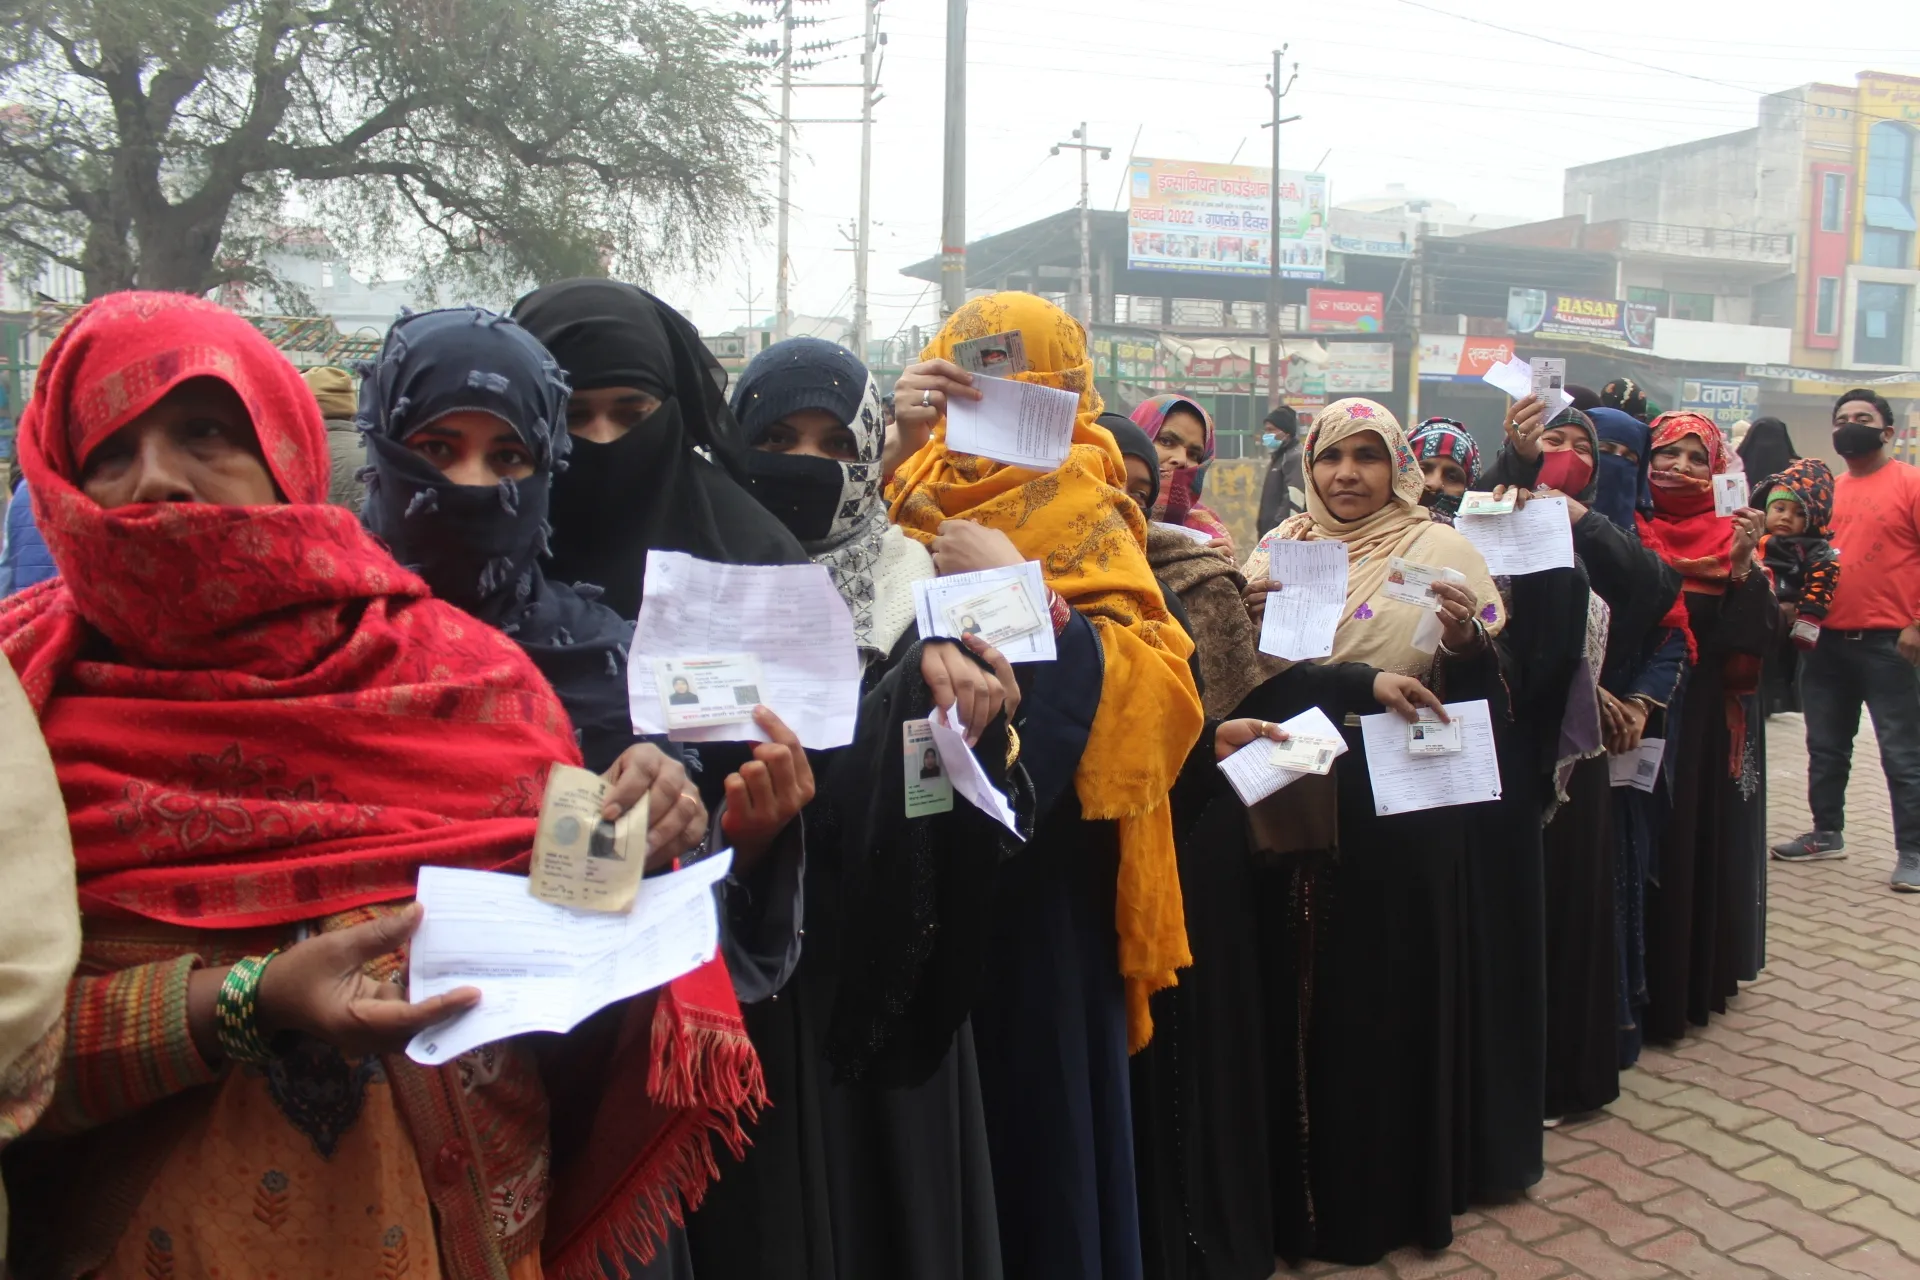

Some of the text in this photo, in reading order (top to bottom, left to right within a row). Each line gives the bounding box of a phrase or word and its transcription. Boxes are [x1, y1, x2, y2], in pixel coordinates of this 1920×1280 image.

[1158, 168, 1217, 194] इन्सानियत
[1132, 204, 1164, 222] नववर्ष
[1168, 209, 1194, 224] 2022
[1205, 210, 1240, 229] गणतंत्र
[1242, 211, 1269, 230] दिवस
[1332, 301, 1377, 313] NEROLAC
[1556, 297, 1618, 318] HASAN
[1555, 313, 1616, 326] ALUMINIUM
[1702, 385, 1740, 404] ताज
